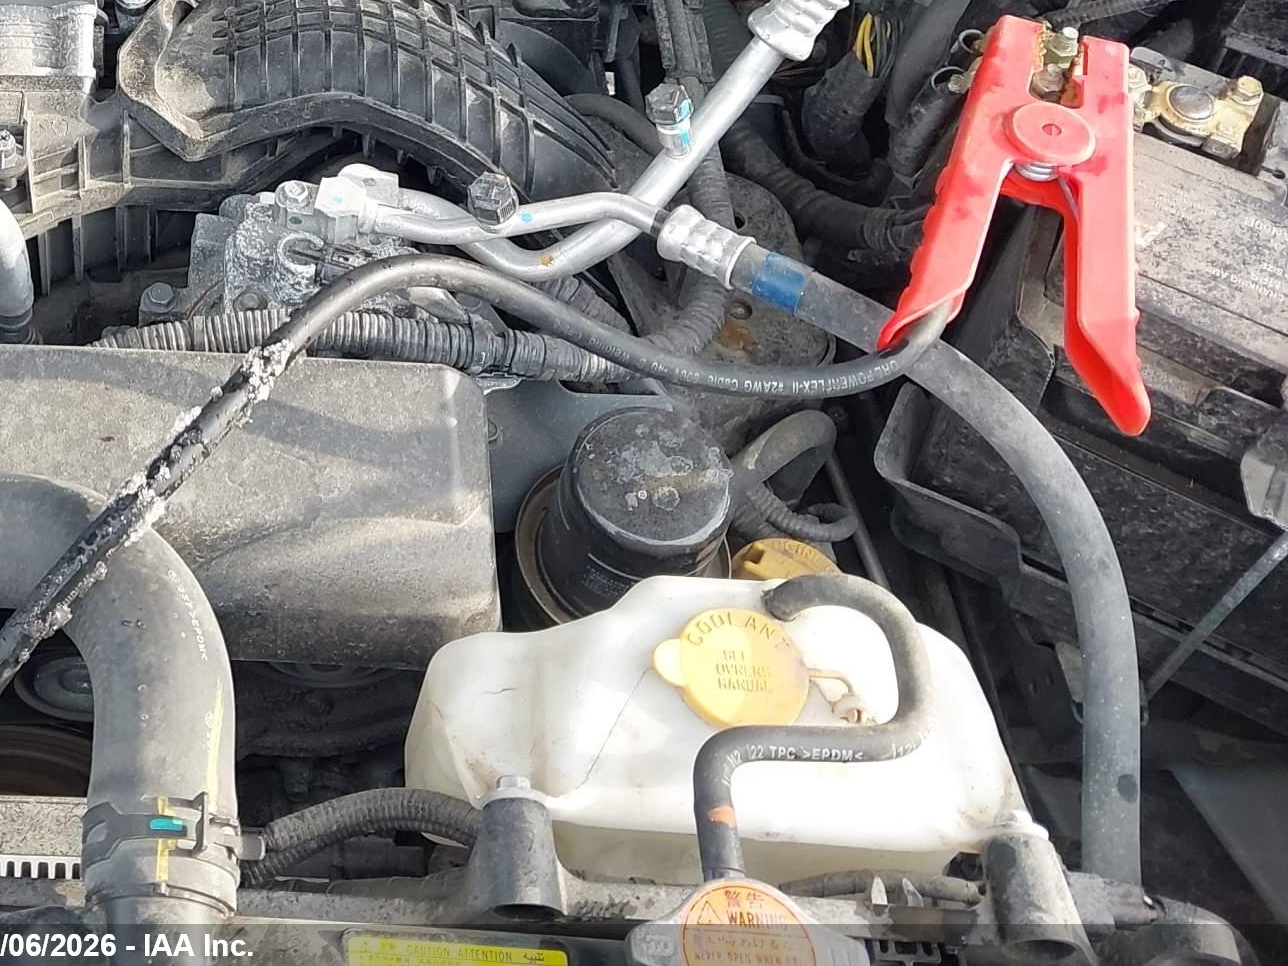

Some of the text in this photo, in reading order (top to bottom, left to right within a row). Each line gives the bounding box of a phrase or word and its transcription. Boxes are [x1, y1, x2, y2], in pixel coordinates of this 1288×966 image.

[686, 611, 792, 649] COOLANT
[726, 911, 788, 931] WARNING
[406, 945, 451, 957] CAUTION
[457, 949, 513, 962] ATTENTION
